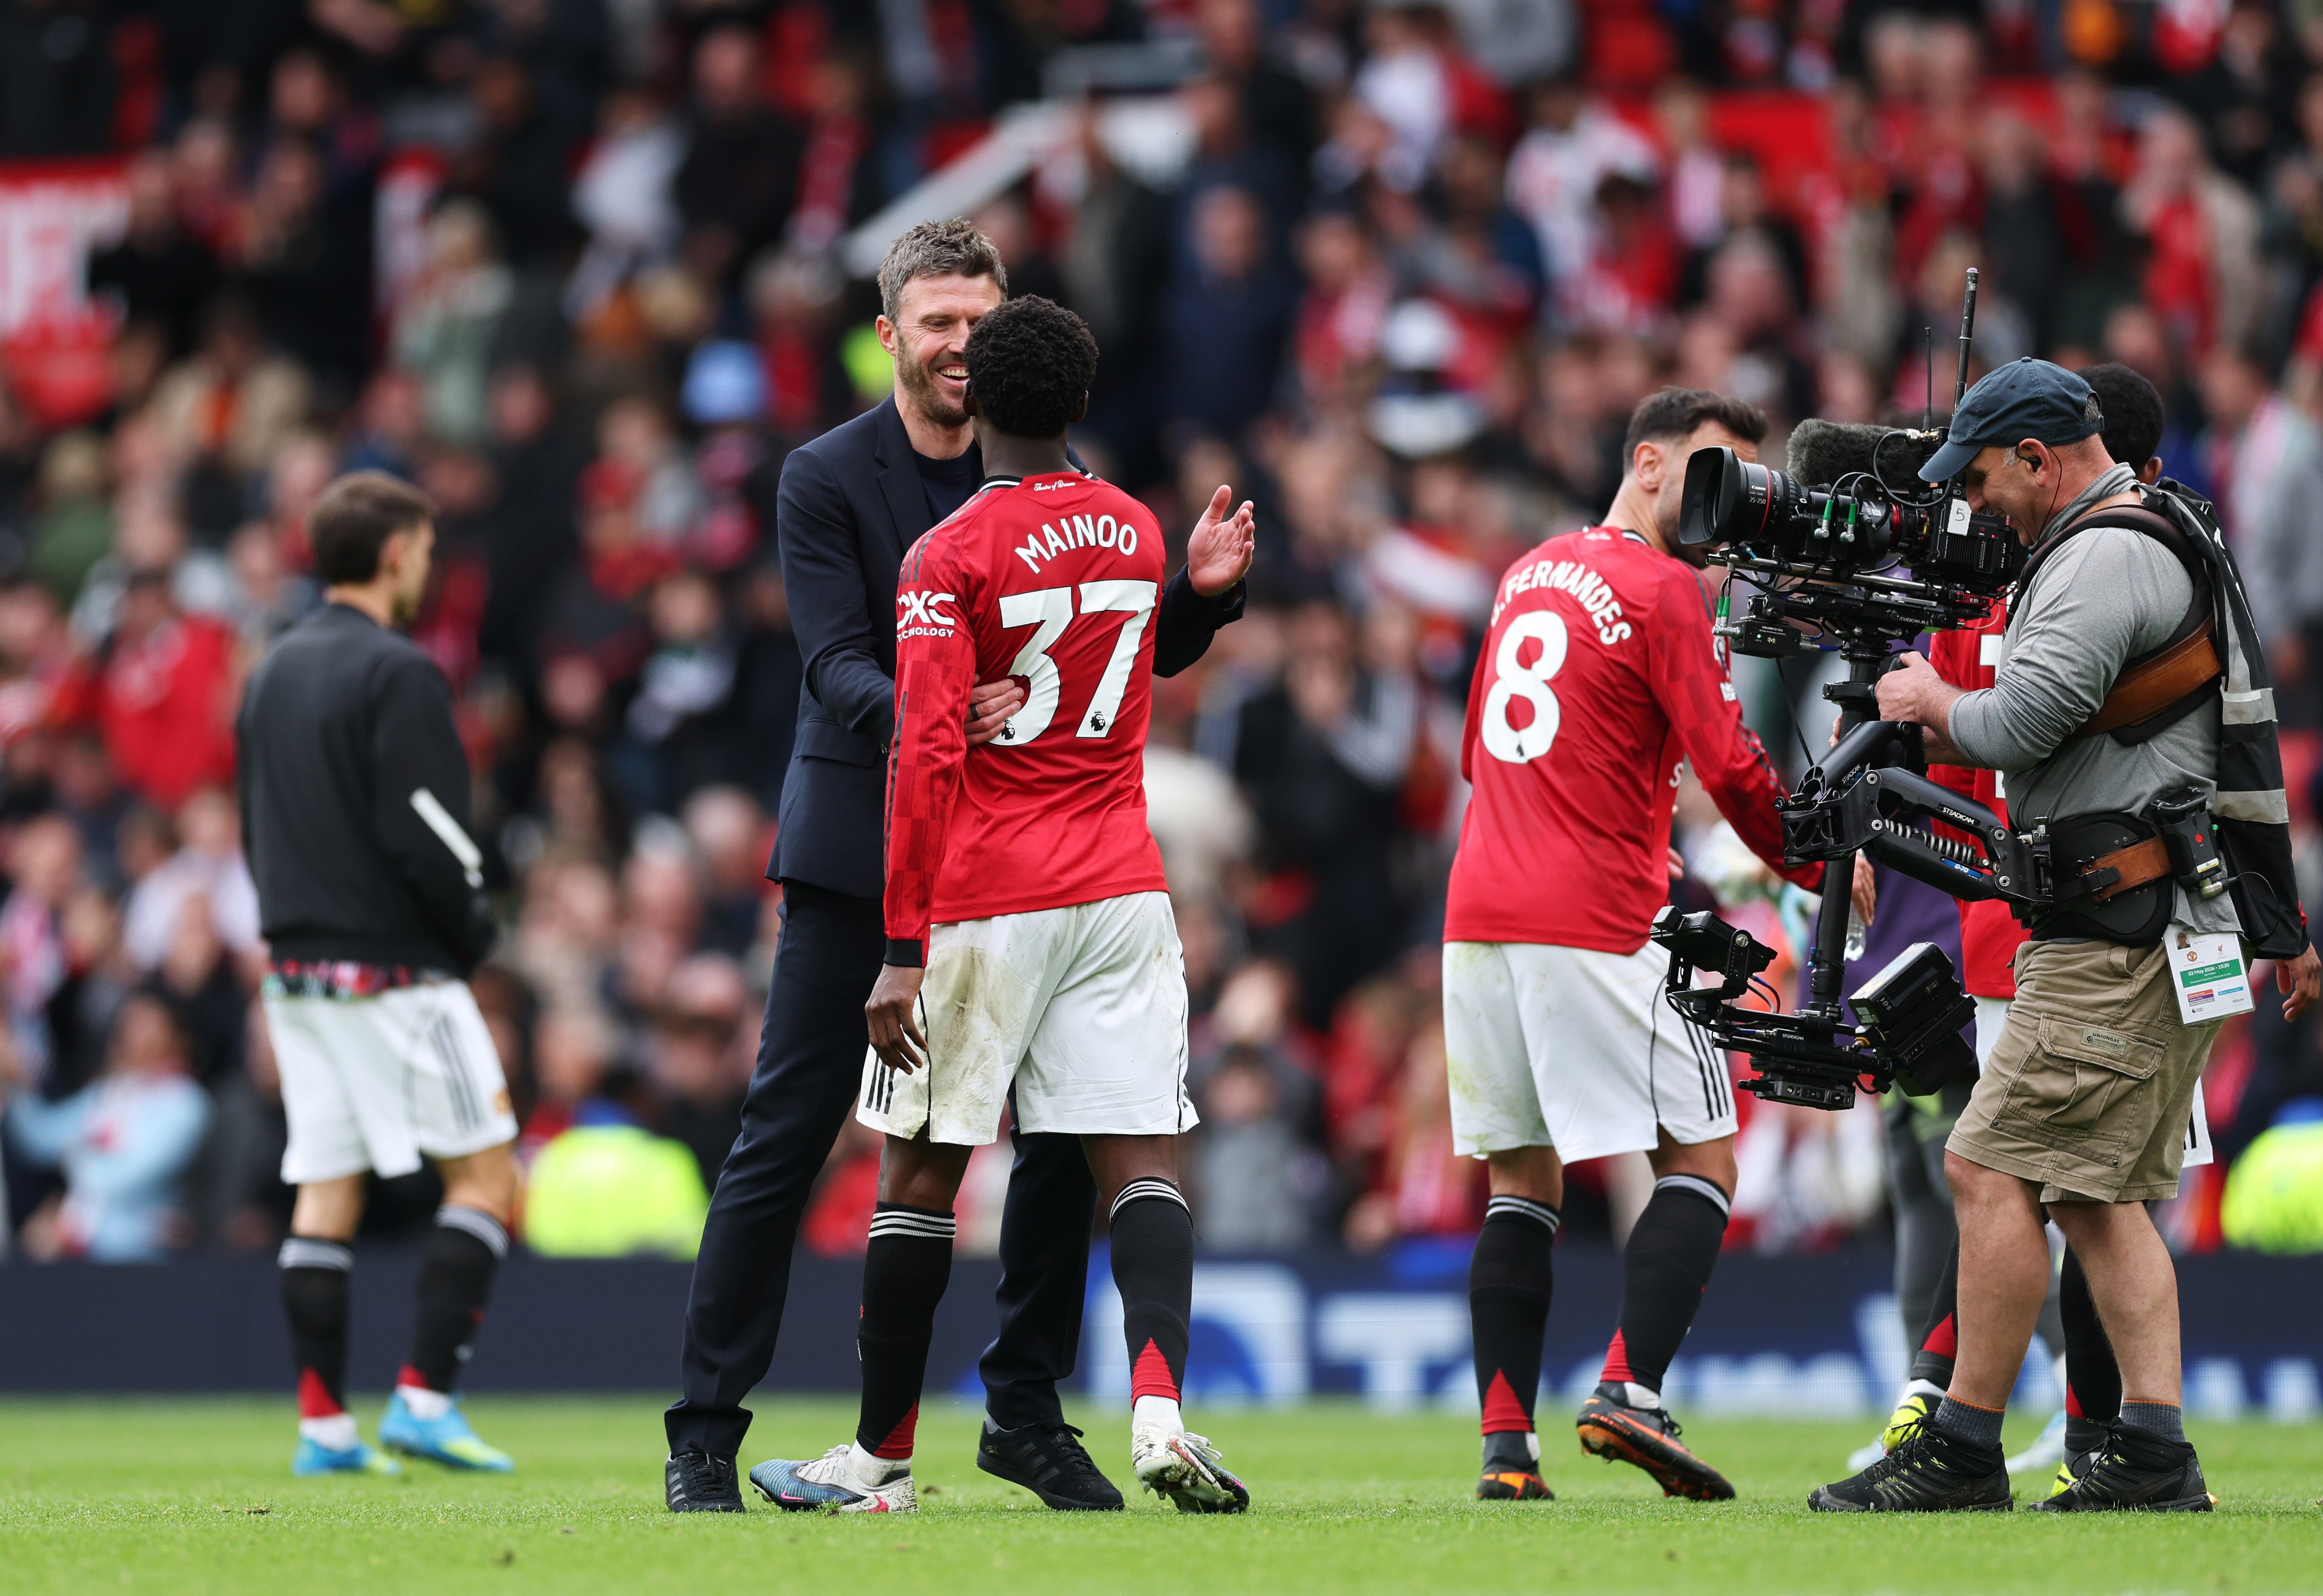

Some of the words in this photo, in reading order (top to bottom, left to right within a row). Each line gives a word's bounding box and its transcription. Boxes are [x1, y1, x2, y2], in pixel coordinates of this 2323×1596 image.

[1750, 497, 1766, 505] 25-250
[1015, 514, 1137, 574] MAINOO
[1505, 560, 1632, 645] FERNANDES
[896, 627, 954, 643] TCNOLOGY
[988, 579, 1158, 747] 37
[1481, 610, 1568, 764] 8
[1841, 764, 1861, 784] STEADICAM
[1943, 806, 1975, 825] STEADICAM
[1955, 863, 1969, 873] G-70
